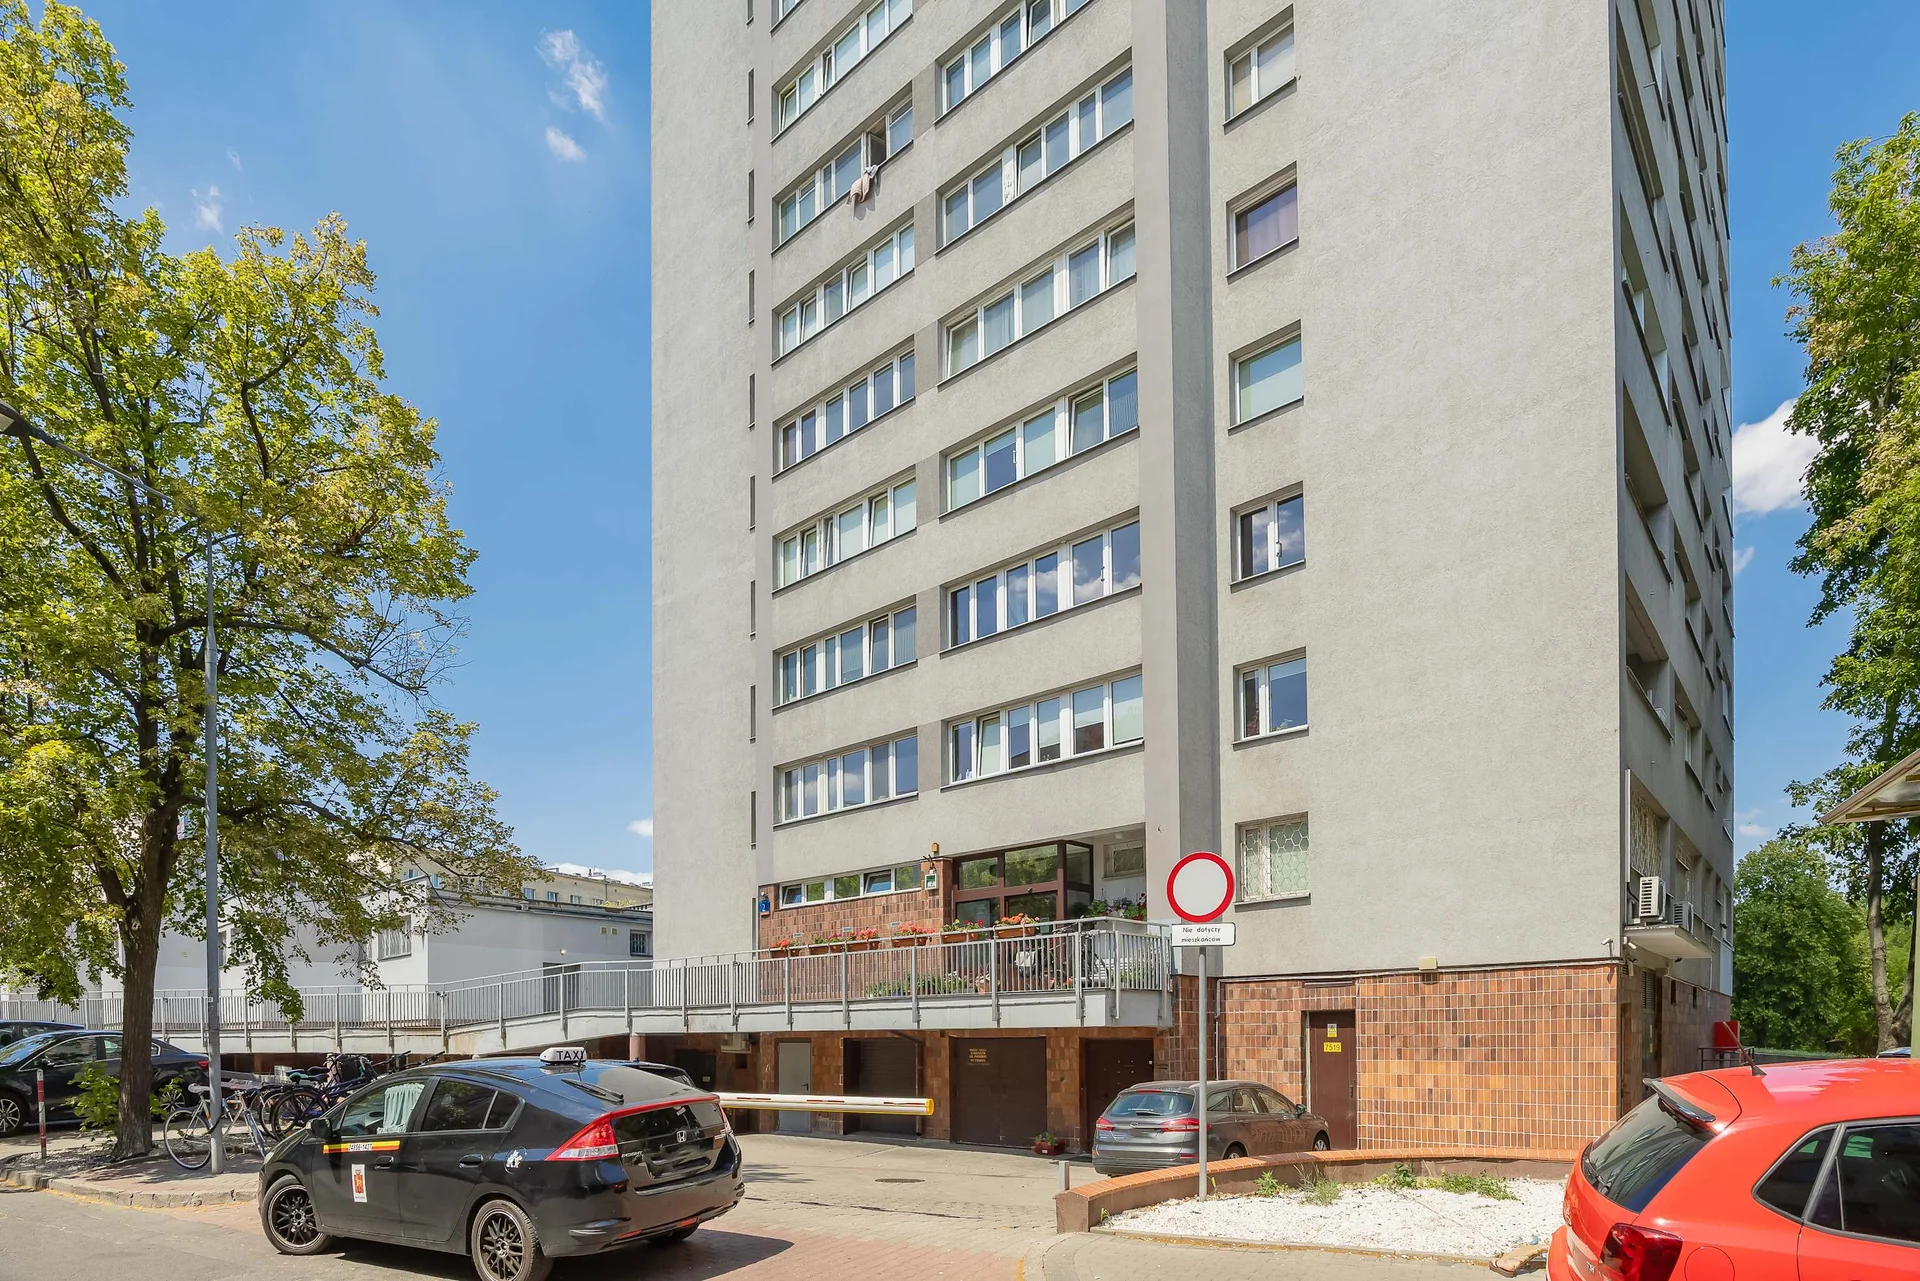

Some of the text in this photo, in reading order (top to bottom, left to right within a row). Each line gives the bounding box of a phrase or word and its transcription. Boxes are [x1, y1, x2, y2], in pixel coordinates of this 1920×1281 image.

[1196, 926, 1221, 934] dotyczy
[1325, 1043, 1341, 1051] 7519
[556, 1050, 585, 1061] TAXI
